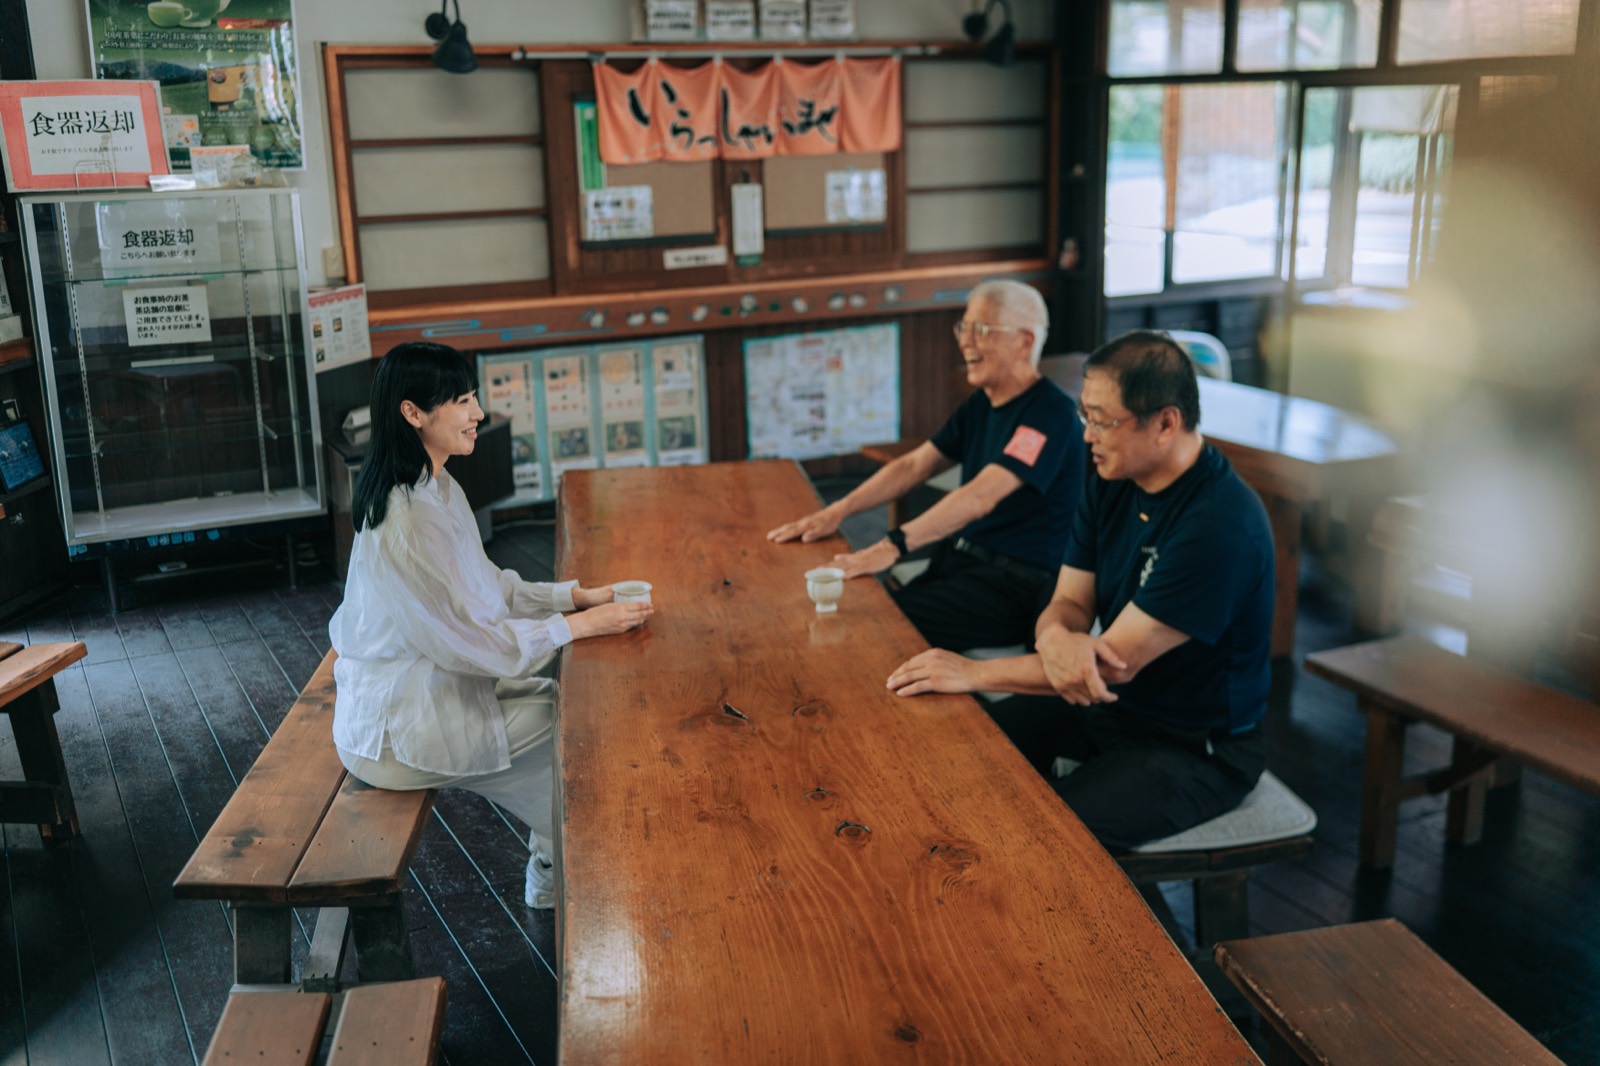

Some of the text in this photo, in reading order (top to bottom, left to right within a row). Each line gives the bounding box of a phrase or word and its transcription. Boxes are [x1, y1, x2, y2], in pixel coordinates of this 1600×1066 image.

[28, 109, 136, 137] 食器返却
[627, 80, 839, 151] いらっしゃいませ
[122, 228, 195, 249] 食器返却
